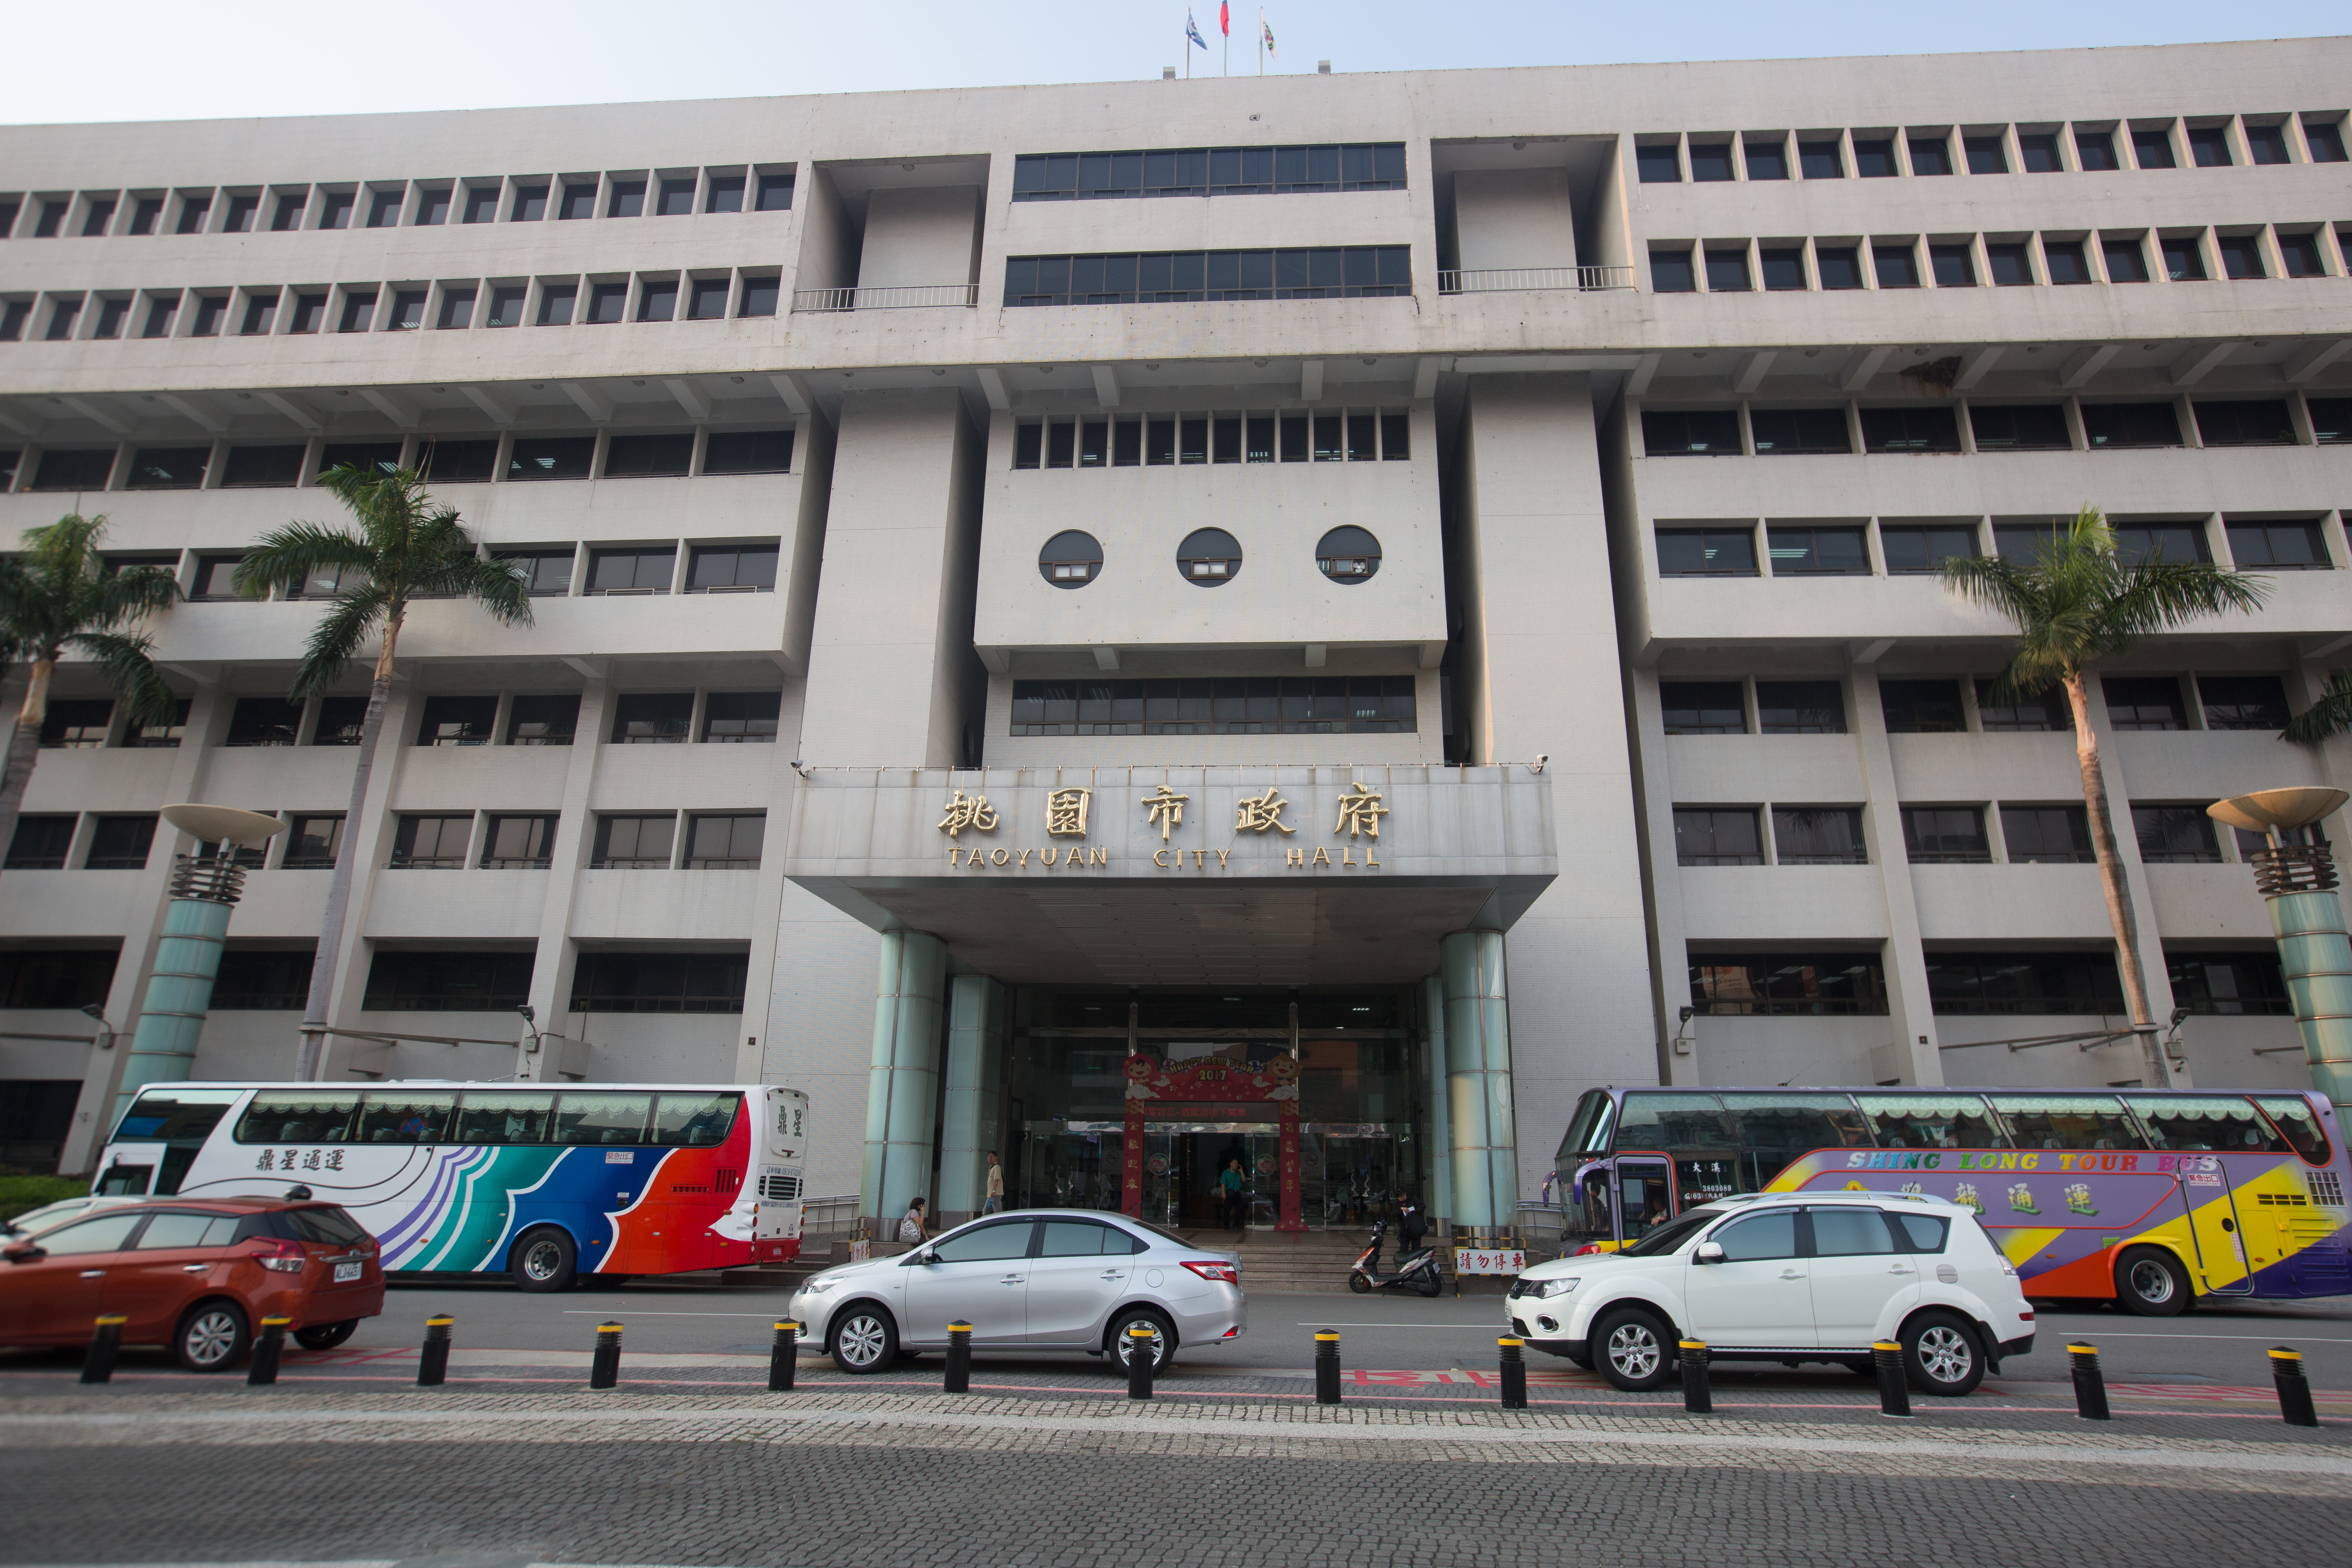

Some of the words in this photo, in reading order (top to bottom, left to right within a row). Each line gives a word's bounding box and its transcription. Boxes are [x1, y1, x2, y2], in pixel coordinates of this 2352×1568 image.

[938, 782, 1389, 842] 桃園市政府
[949, 848, 1107, 868] TAOYUAN
[1154, 849, 1231, 869] CITY
[1288, 848, 1380, 867] HALL
[1169, 1056, 1203, 1074] HAPPY
[1205, 1056, 1227, 1066] NEW
[1229, 1058, 1254, 1075] YEAR
[1198, 1069, 1227, 1080] 2017
[777, 1105, 802, 1137] 鼎星
[255, 1149, 345, 1171] 鼎星通運
[1126, 1121, 1139, 1189] 金雞迎春
[1846, 1152, 1941, 1169] SHING
[1958, 1153, 2038, 1170] LONG
[2059, 1154, 2138, 1171] TOUR
[2157, 1155, 2217, 1172] BUS
[1693, 1162, 1720, 1172] 大溪
[851, 1241, 869, 1262] 請勿停車
[1460, 1252, 1523, 1272] 請勿停車
